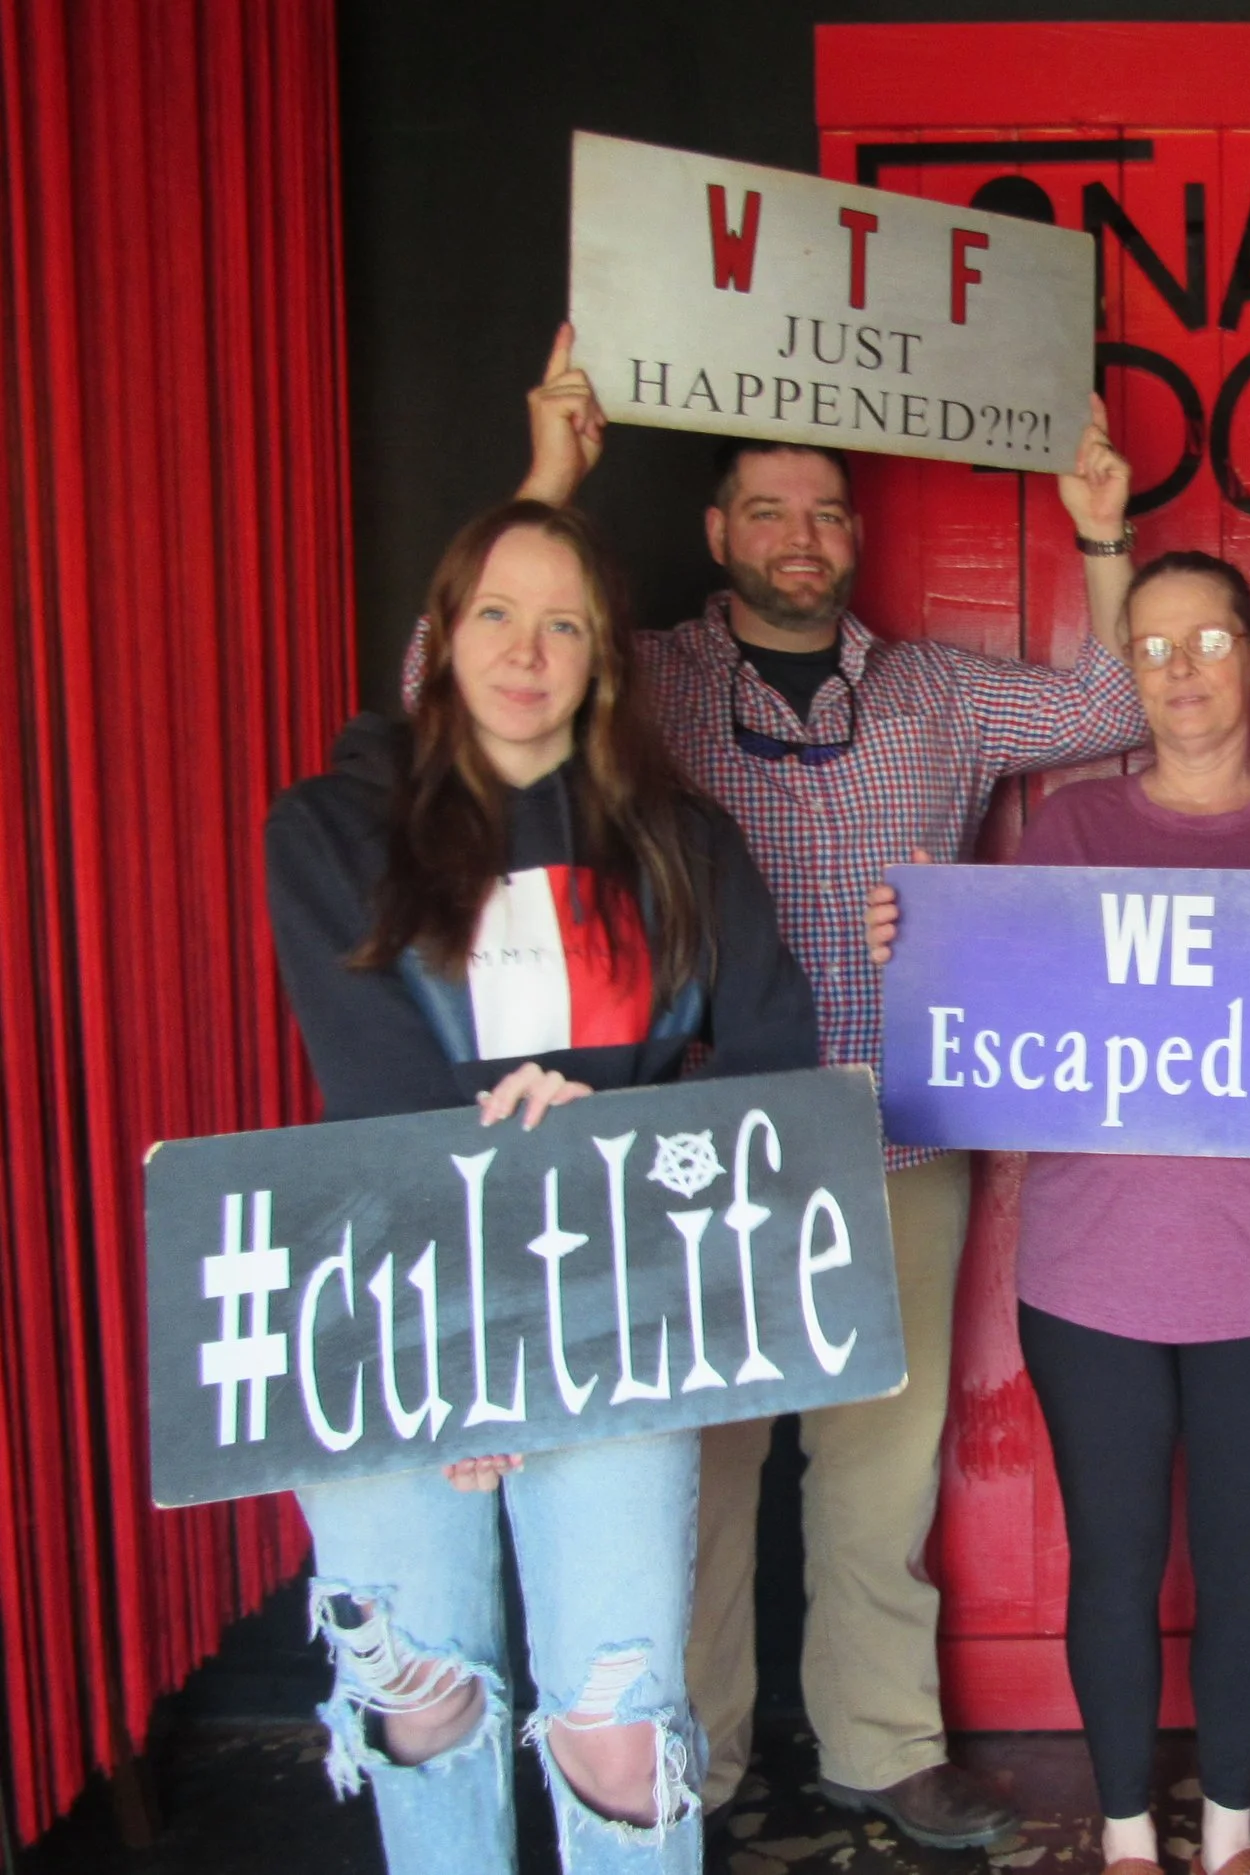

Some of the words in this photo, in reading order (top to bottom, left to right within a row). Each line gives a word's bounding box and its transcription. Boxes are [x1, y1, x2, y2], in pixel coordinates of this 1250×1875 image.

[777, 314, 923, 375] JUST
[628, 357, 1052, 454] HAPPENED?!?!
[1100, 892, 1216, 987] WE
